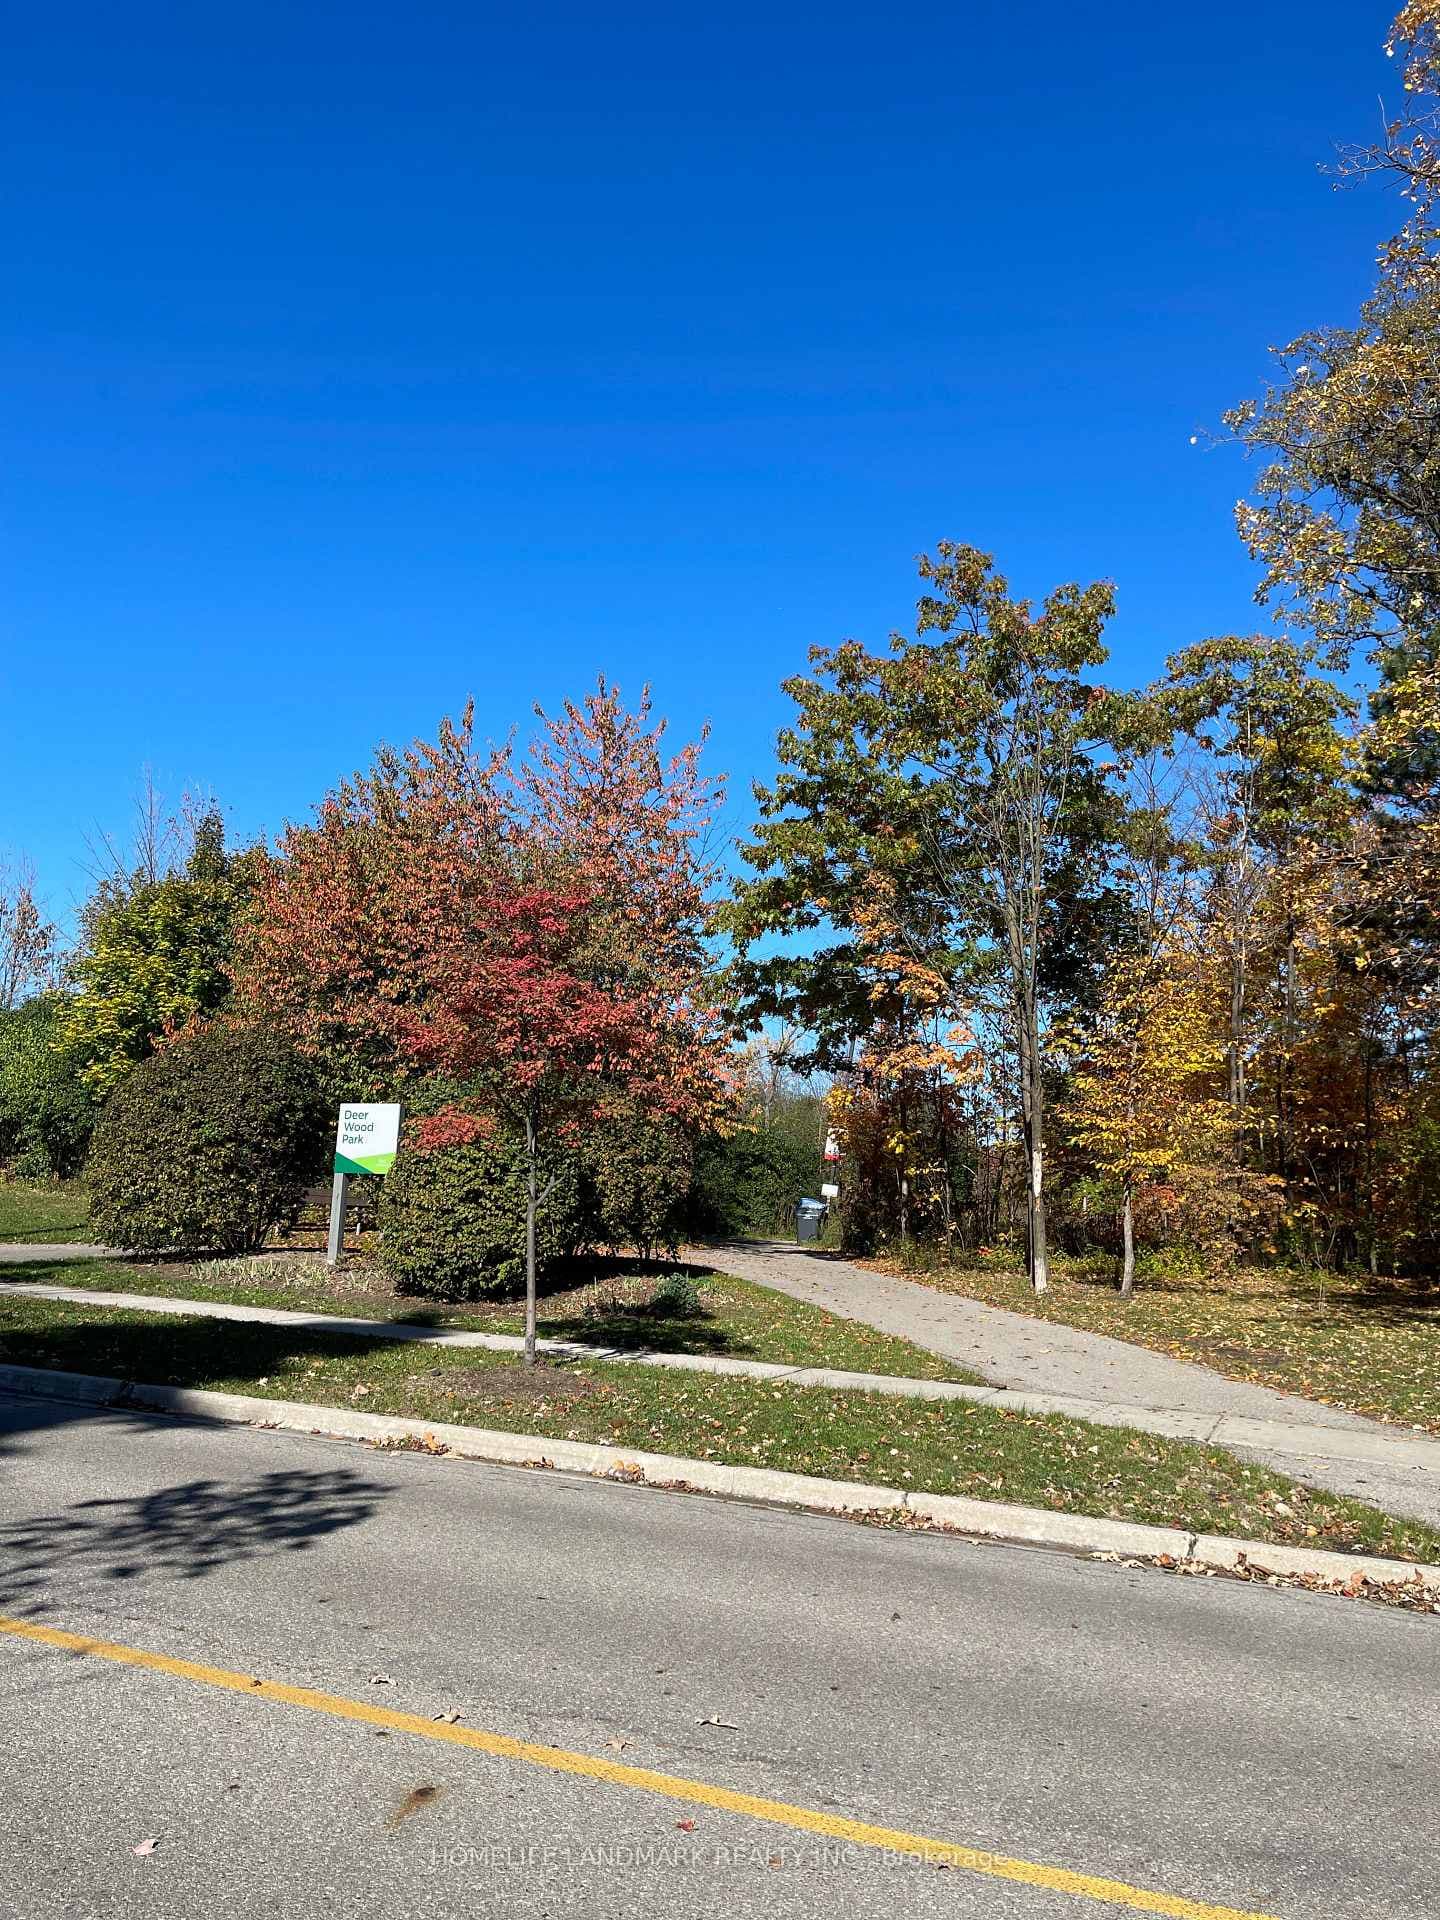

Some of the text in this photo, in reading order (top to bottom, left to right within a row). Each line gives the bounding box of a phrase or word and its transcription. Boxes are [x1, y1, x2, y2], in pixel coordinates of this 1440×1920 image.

[344, 1110, 369, 1120] Deer
[344, 1122, 374, 1132] Wood
[342, 1135, 364, 1144] Park
